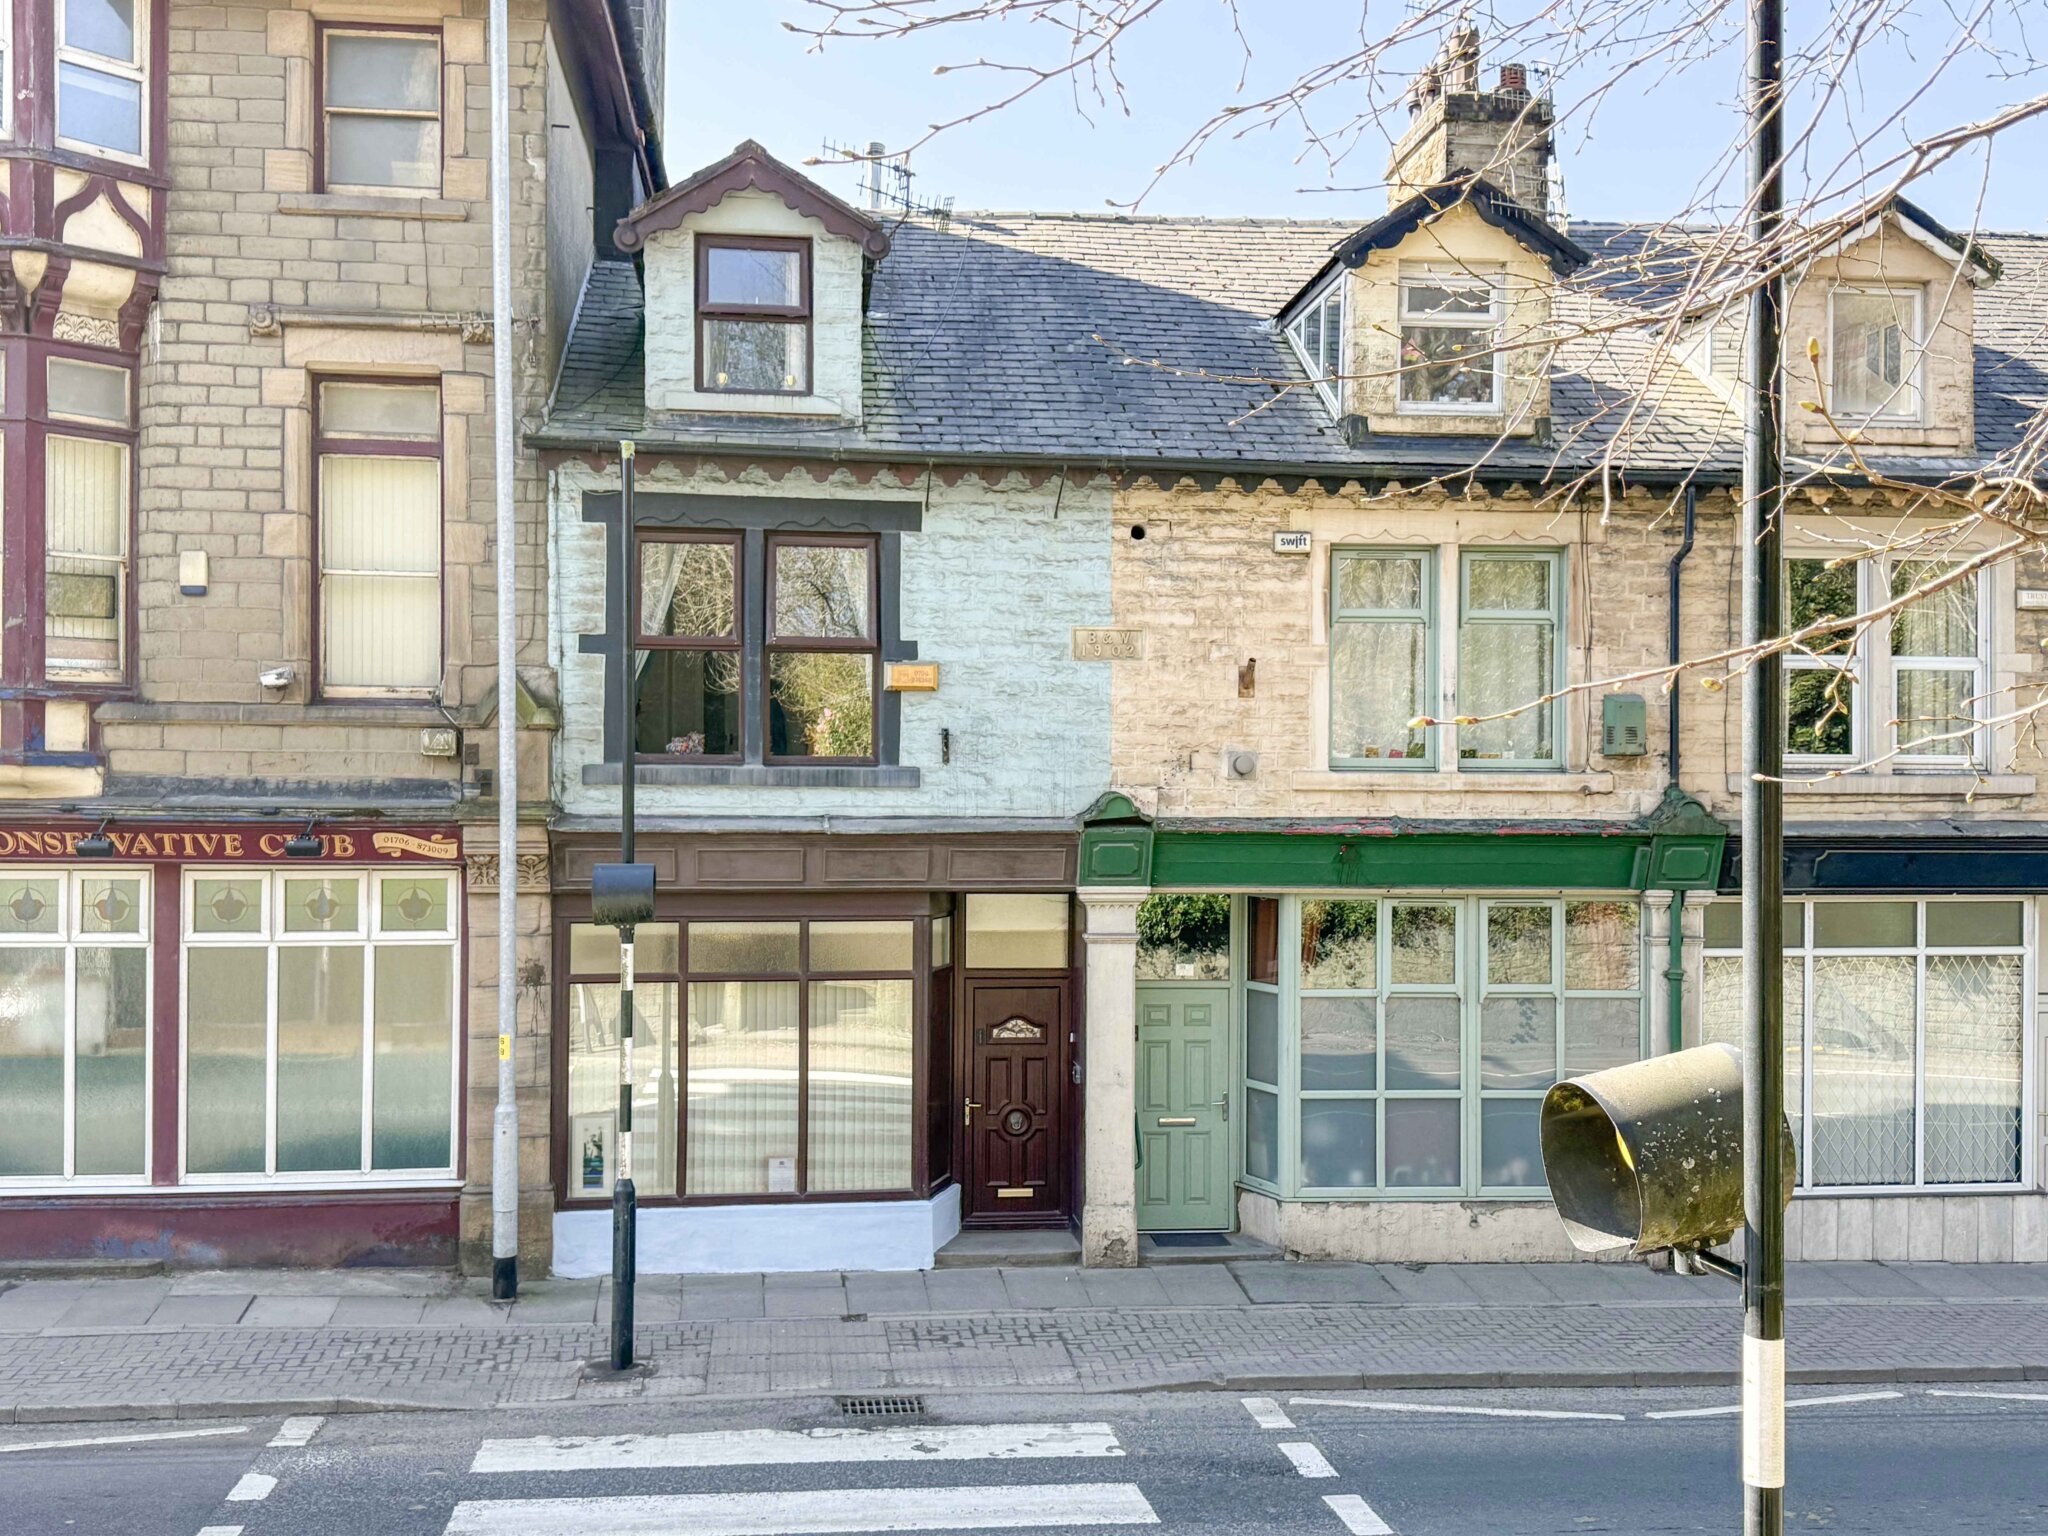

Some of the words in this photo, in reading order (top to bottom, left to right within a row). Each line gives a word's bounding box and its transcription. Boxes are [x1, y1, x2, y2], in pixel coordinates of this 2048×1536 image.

[1281, 534, 1307, 549] swift
[1088, 631, 1097, 644] B
[1103, 632, 1113, 644] &
[1119, 631, 1131, 644] W
[1081, 644, 1135, 658] 1902
[0, 831, 244, 856] ONSEVATIVE
[383, 836, 410, 846] 01706
